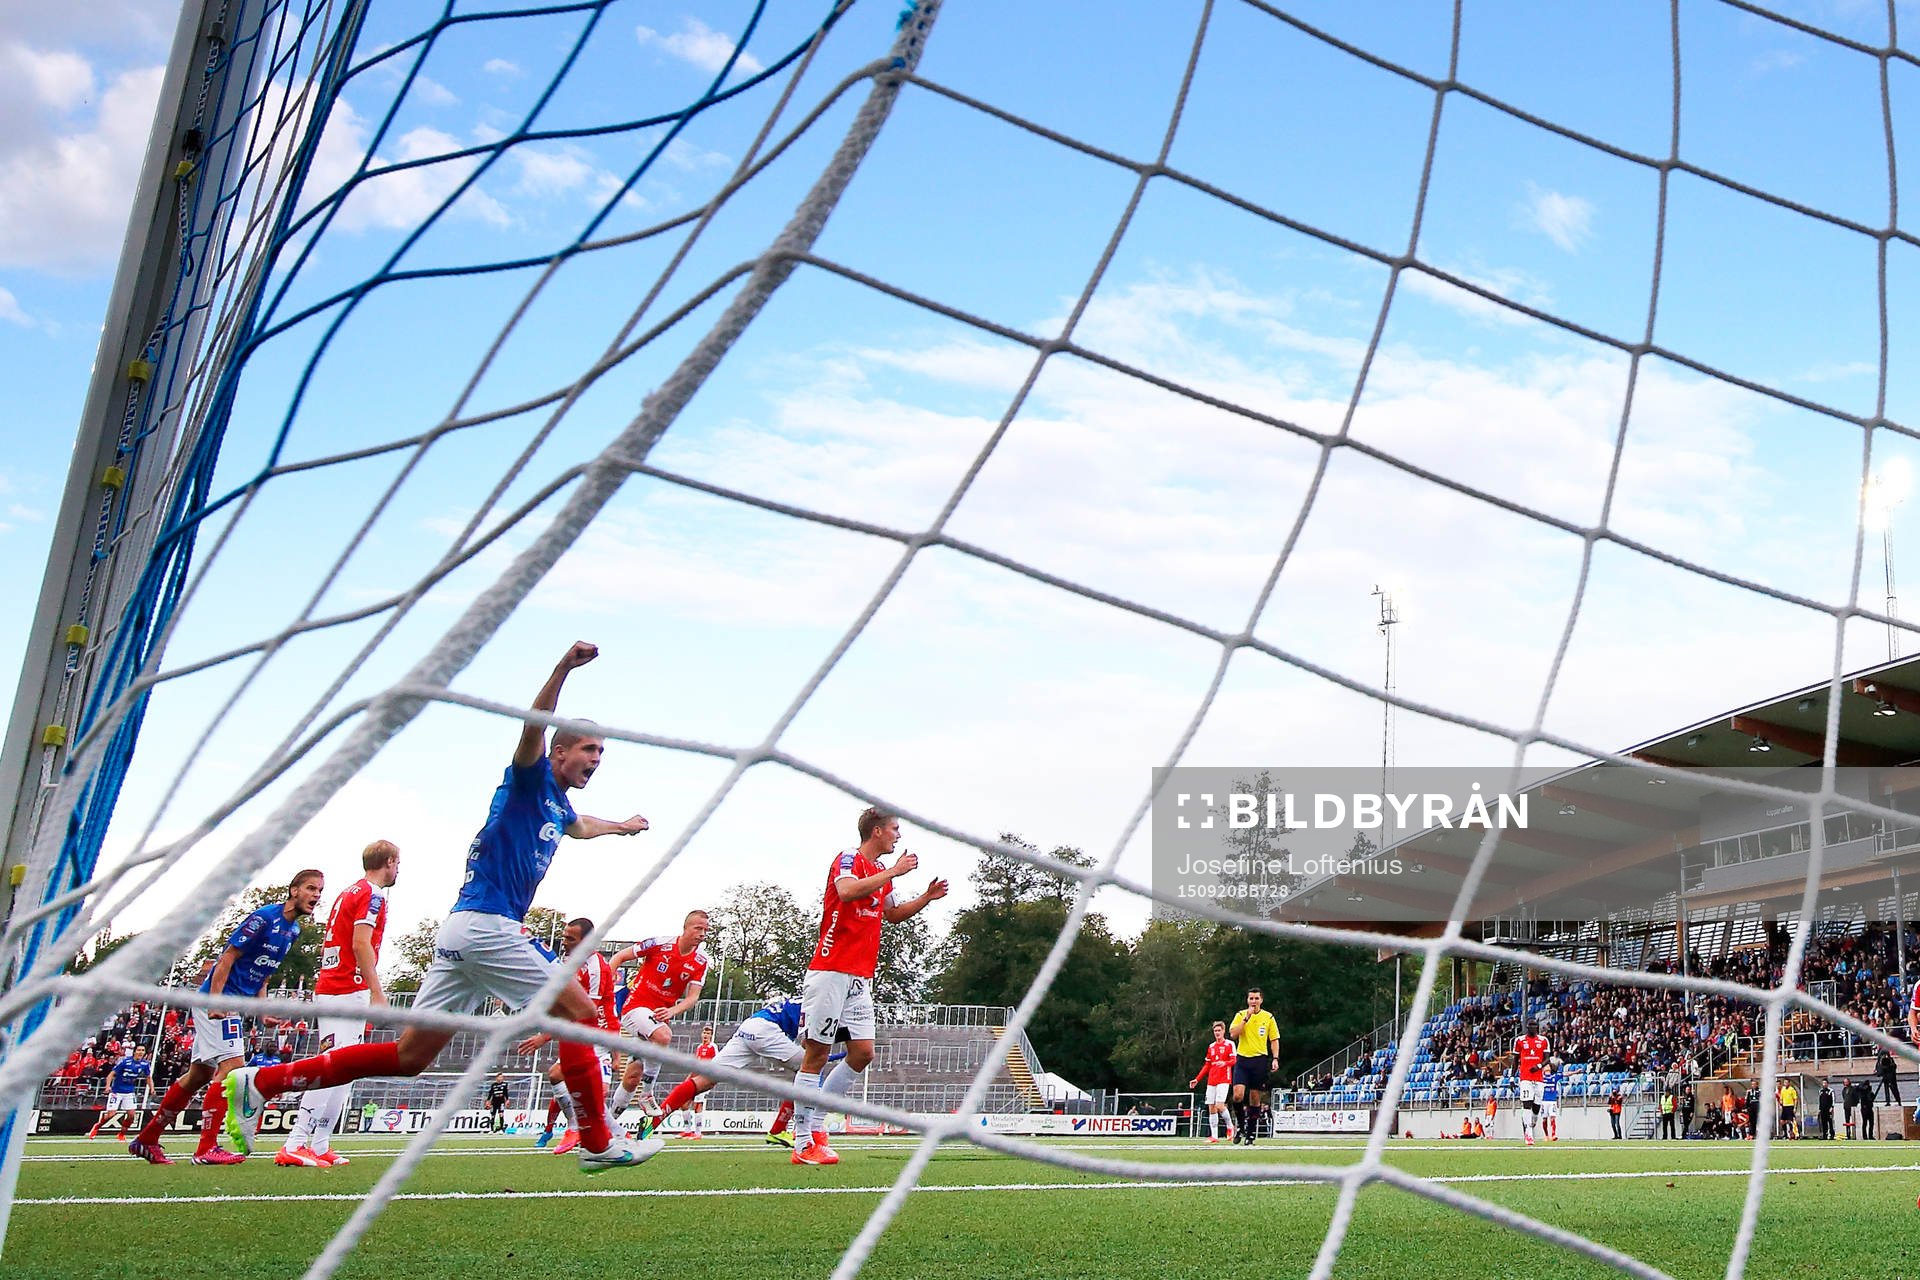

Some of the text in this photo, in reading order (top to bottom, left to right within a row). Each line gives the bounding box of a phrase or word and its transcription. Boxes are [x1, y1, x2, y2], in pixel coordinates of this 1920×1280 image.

[820, 1017, 839, 1038] 23
[723, 1117, 764, 1129] ConLink
[1088, 1118, 1174, 1132] INTERSPORT
